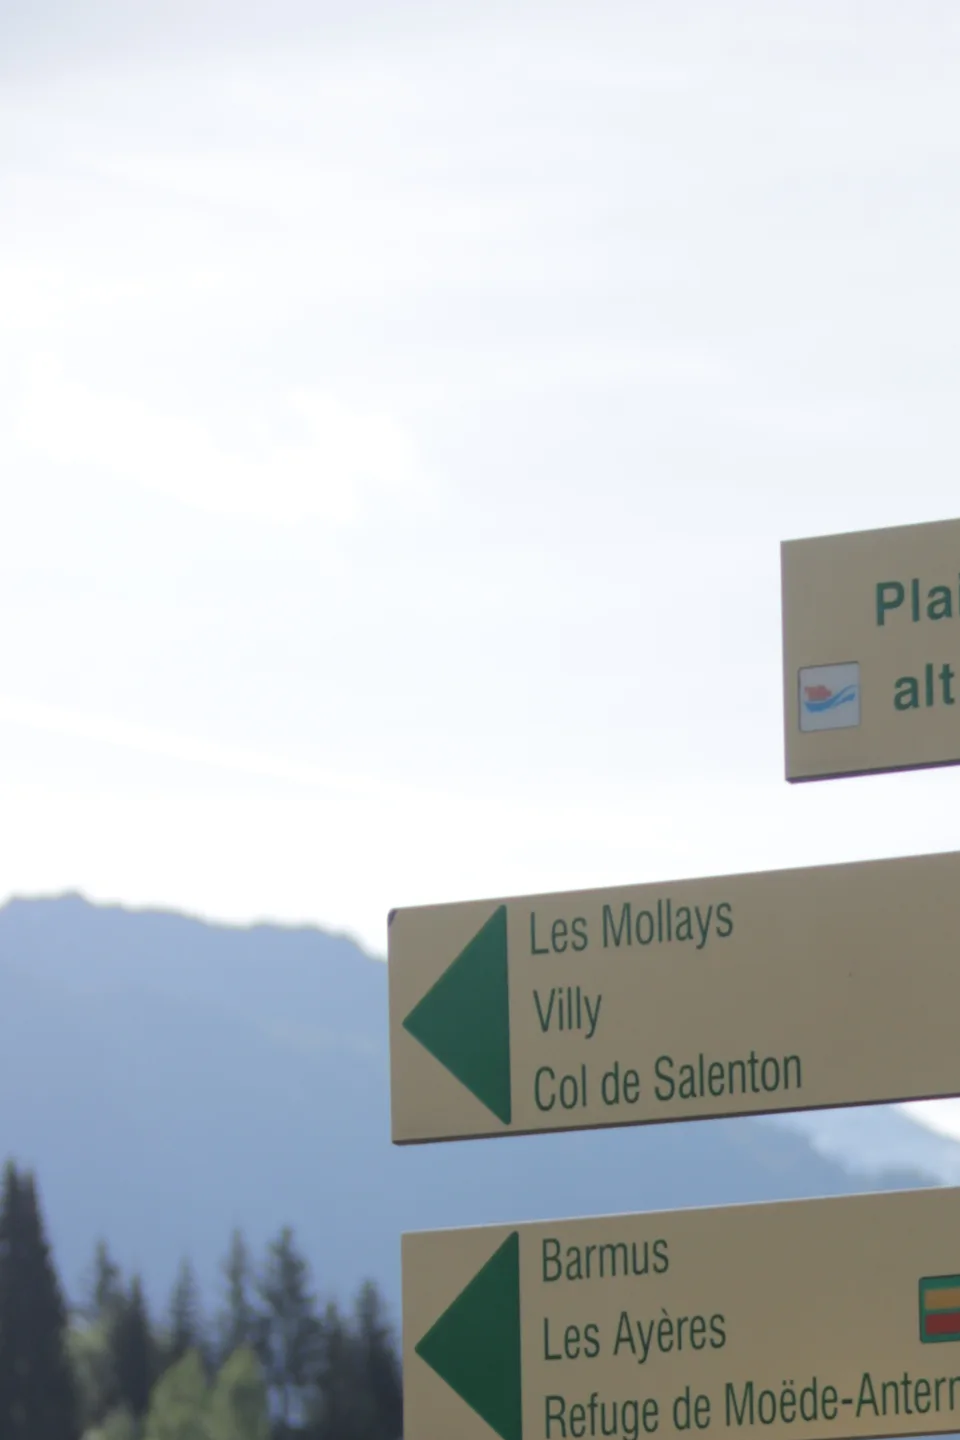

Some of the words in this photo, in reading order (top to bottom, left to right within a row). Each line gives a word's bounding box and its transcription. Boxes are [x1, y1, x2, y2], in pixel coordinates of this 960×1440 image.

[531, 912, 587, 955] Les
[603, 899, 733, 949] Mollays
[533, 987, 601, 1039] Villy
[535, 1064, 586, 1111] Col
[602, 1061, 639, 1105] de
[655, 1051, 801, 1100] Salenton
[543, 1239, 668, 1282] Barmus
[544, 1318, 600, 1360] Les
[614, 1309, 725, 1364] Ayères
[673, 1386, 710, 1430] de
